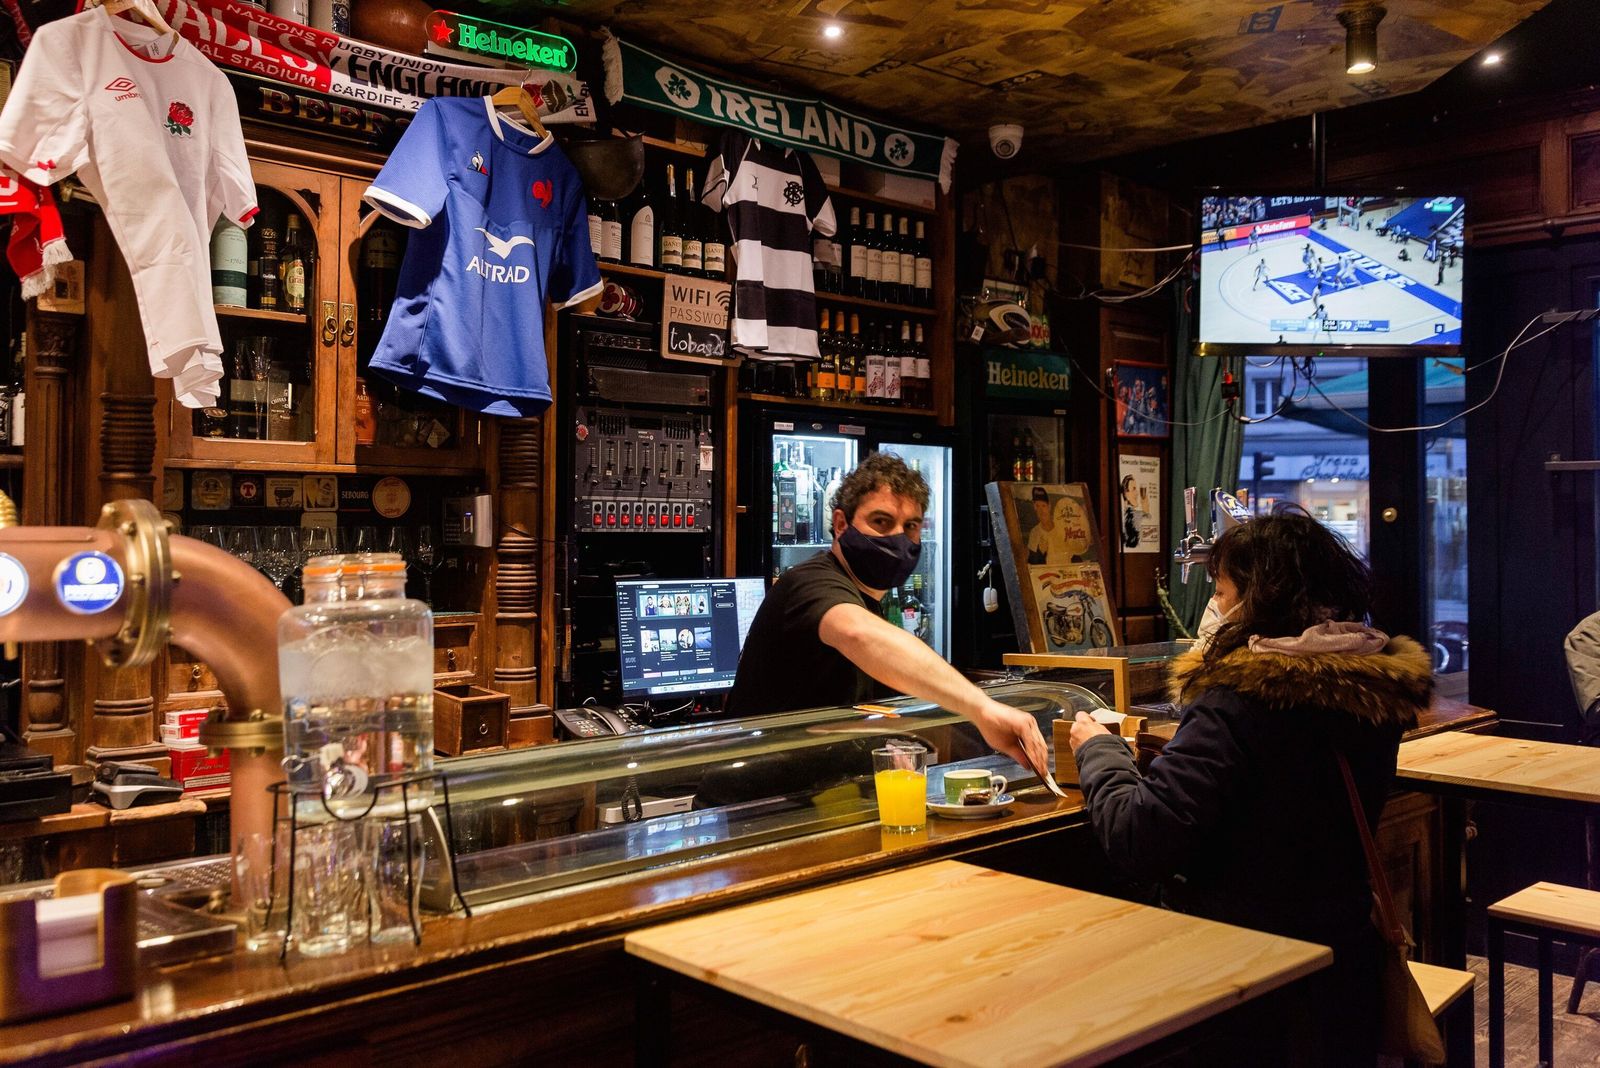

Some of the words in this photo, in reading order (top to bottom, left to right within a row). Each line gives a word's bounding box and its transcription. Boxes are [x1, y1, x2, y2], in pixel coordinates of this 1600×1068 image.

[226, 3, 317, 42] NATIONS
[321, 37, 392, 62] RUGBY
[392, 52, 446, 74] UNION
[458, 22, 569, 68] Heineken
[230, 53, 316, 87] STADIUM
[331, 82, 406, 110] CARDIFF,
[705, 84, 877, 158] IRELAND
[465, 255, 530, 283] ALTRAD
[671, 284, 711, 307] WIFI
[987, 361, 1070, 390] Heineken
